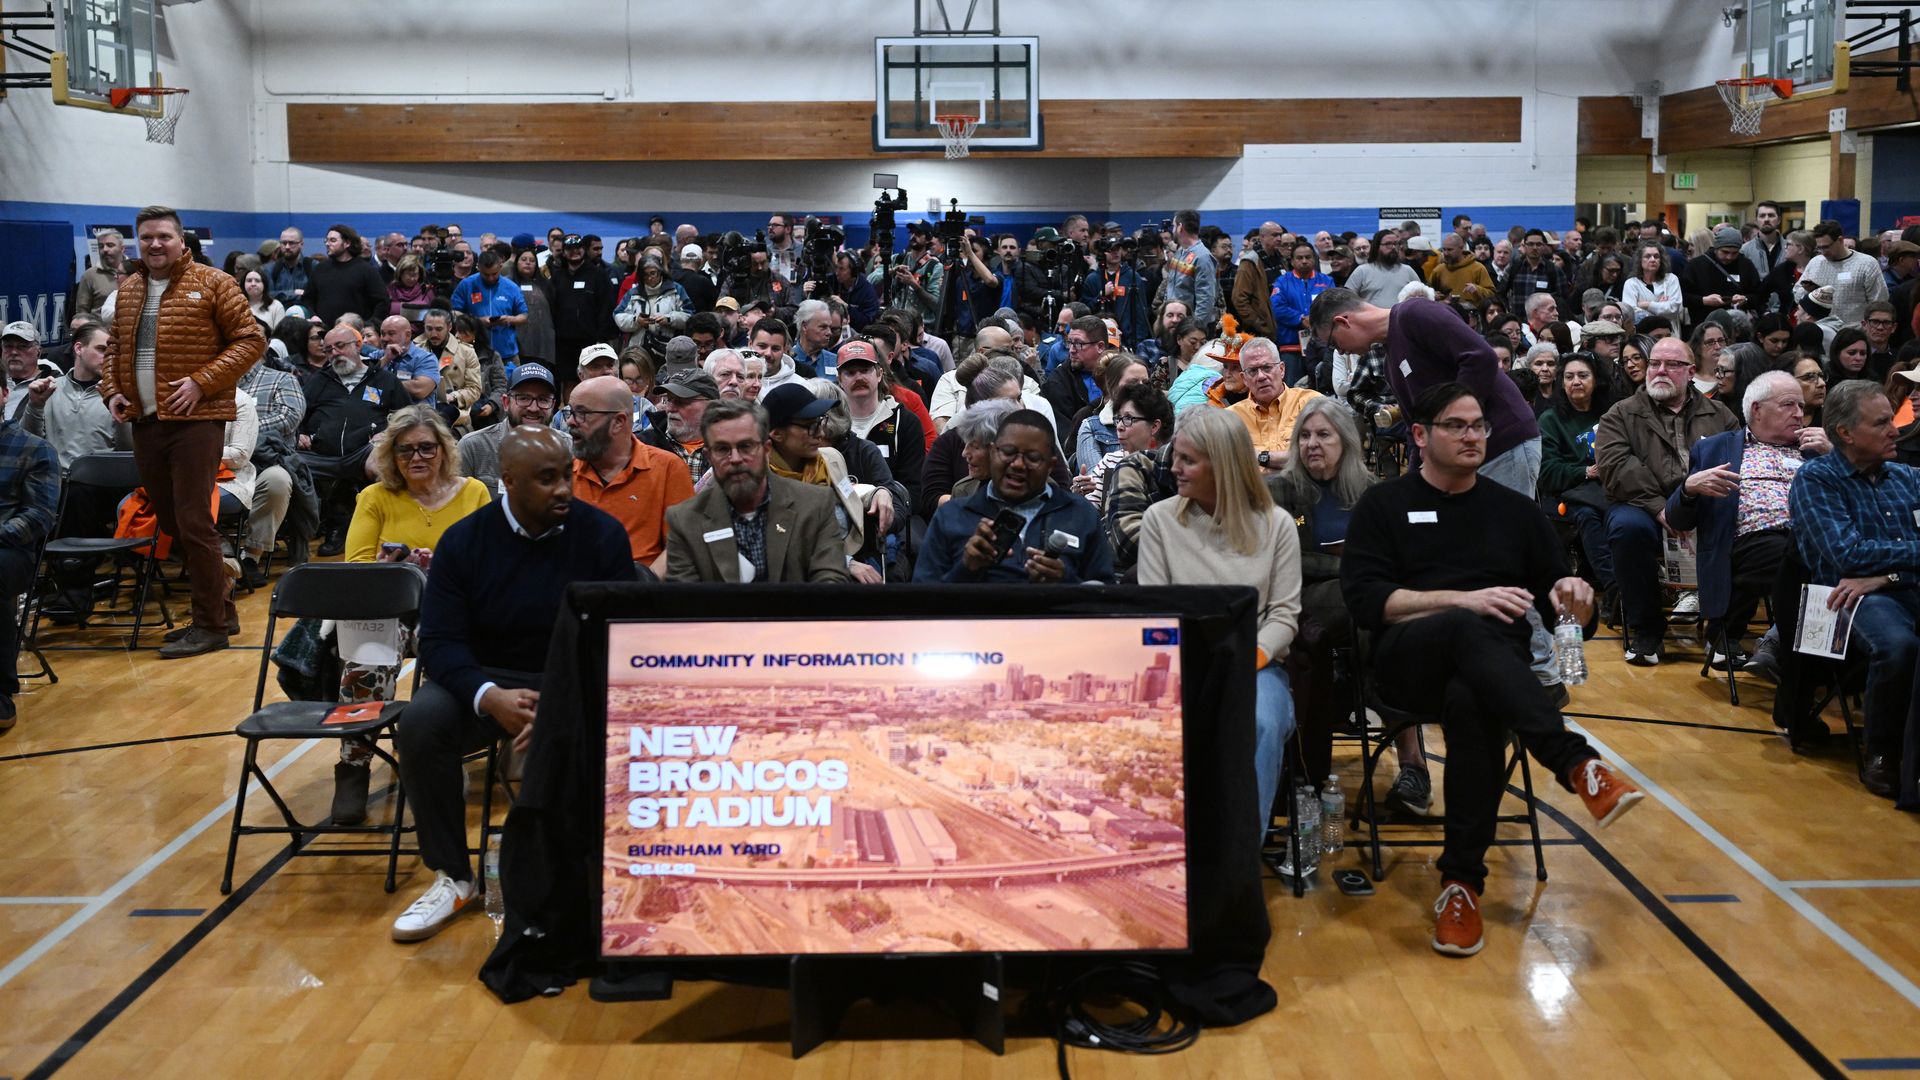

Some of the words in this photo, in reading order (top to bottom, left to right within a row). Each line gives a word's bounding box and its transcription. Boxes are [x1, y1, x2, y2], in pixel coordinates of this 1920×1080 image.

[1679, 174, 1695, 187] EXIT
[630, 654, 755, 668] COMMUNITY
[763, 653, 904, 667] INFORMATION
[629, 725, 738, 757] NEW
[628, 760, 848, 792] BRONCOS
[627, 796, 832, 828] STADIUM
[628, 844, 722, 857] BURNHAM
[731, 843, 781, 856] YARD
